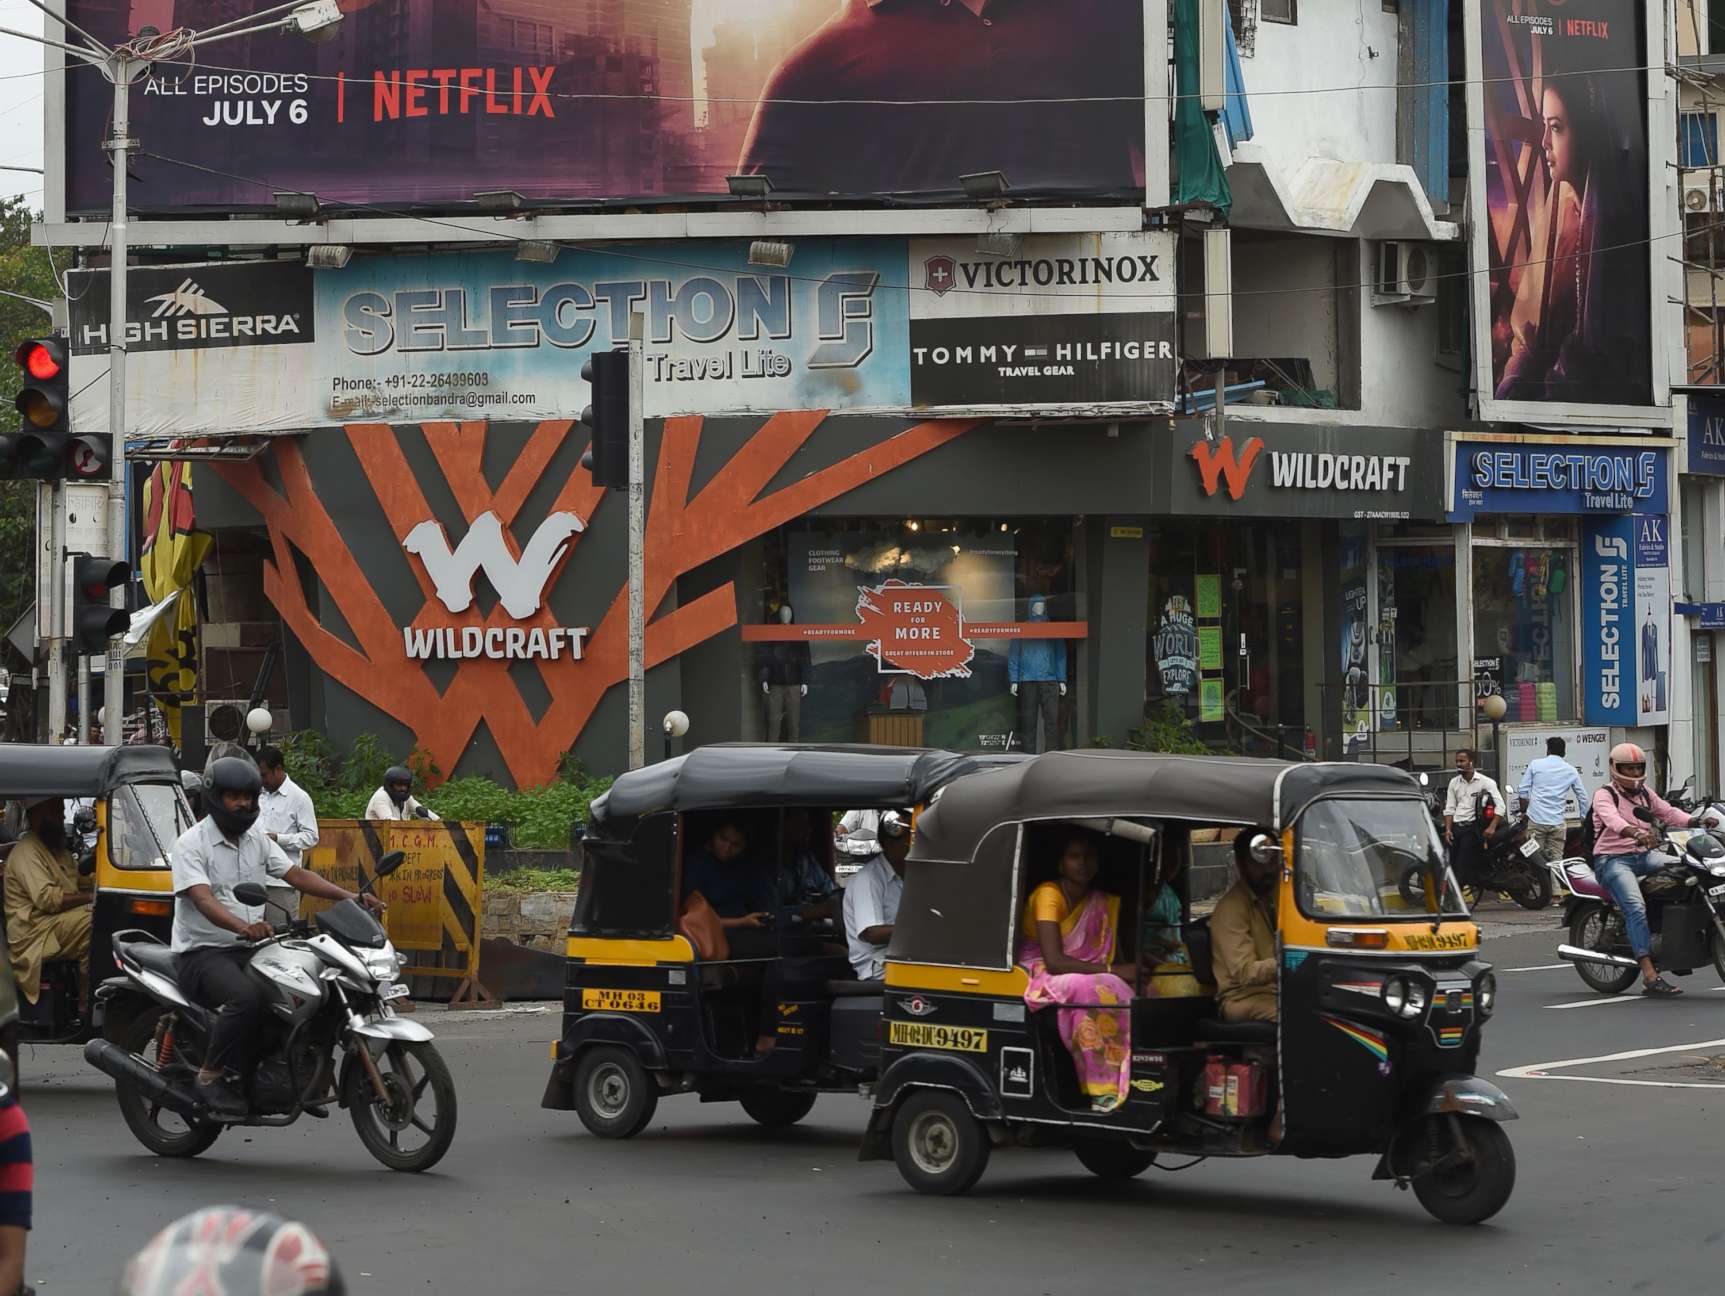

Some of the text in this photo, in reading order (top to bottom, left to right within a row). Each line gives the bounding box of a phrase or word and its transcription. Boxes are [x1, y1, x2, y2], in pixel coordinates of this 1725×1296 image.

[1507, 15, 1552, 25] ALL EPISODES
[1567, 19, 1608, 39] NETFLIX
[1530, 26, 1553, 35] JULY 6
[144, 74, 308, 95] ALL EPISODES
[374, 66, 557, 122] NETFLIX
[203, 99, 308, 126] JULY 6
[959, 254, 1161, 288] VICTORINOX
[343, 275, 792, 356] SELECTION
[83, 315, 300, 345] HGH SIERRA
[913, 341, 1174, 365] TOMMY HILFIGER
[647, 349, 792, 383] Travel Lite
[998, 366, 1075, 377] TRAVEL GEAR
[332, 377, 382, 391] Phone:-
[1271, 451, 1411, 492] WILDCRAFT
[1472, 452, 1634, 491] SELECTION
[1585, 492, 1634, 509] Travel Lite
[1640, 520, 1663, 541] AK
[894, 602, 943, 613] READY
[1355, 596, 1367, 610] UP
[1161, 611, 1194, 627] A HUGE
[403, 626, 590, 660] WILDCRAFT
[895, 627, 941, 640] MORE
[1601, 564, 1620, 709] SELECTION
[1153, 632, 1201, 662] WORLD
[1163, 668, 1192, 685] EXPLORE
[1582, 733, 1607, 743] WENGER
[402, 885, 432, 904] SLOW
[584, 999, 659, 1011] CT 0646
[599, 990, 646, 1001] MH 03
